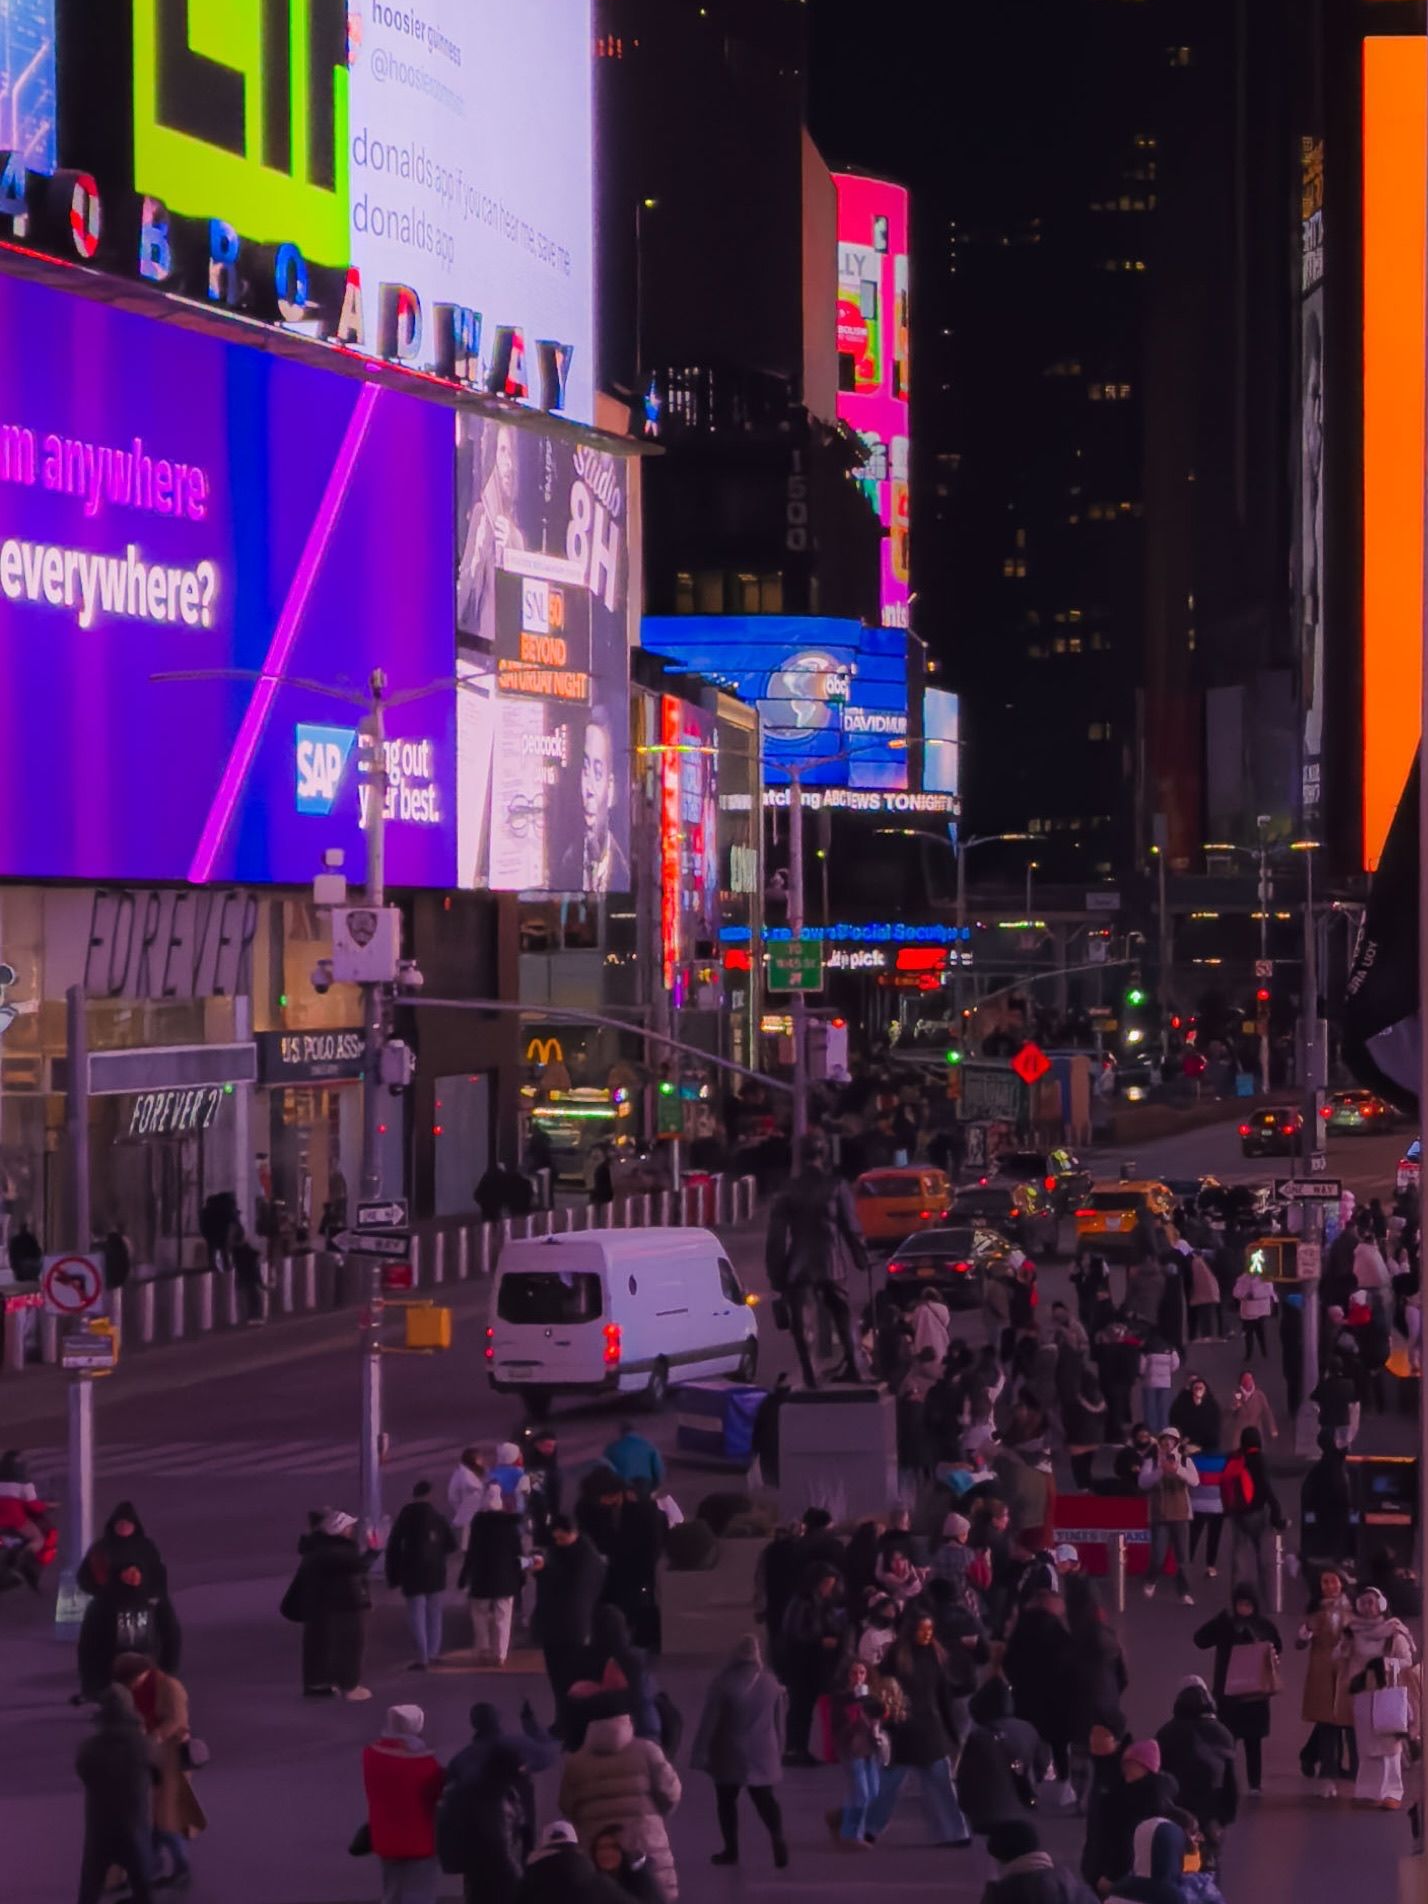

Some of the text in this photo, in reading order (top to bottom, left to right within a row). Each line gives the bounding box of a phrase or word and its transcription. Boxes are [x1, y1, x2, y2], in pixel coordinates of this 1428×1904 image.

[352, 127, 433, 190] donalds
[352, 192, 433, 254] donalds
[138, 194, 575, 412] BROADWAY
[44, 433, 210, 520] anywhere
[0, 538, 216, 629] everywhere?
[519, 632, 567, 666] BEYOND
[549, 672, 588, 699] NIGHT
[297, 738, 429, 799] SAP out
[399, 784, 440, 824] best.
[84, 889, 259, 999] FOREVER
[303, 1035, 336, 1062] POLO
[129, 1087, 224, 1135] FOREVER 21
